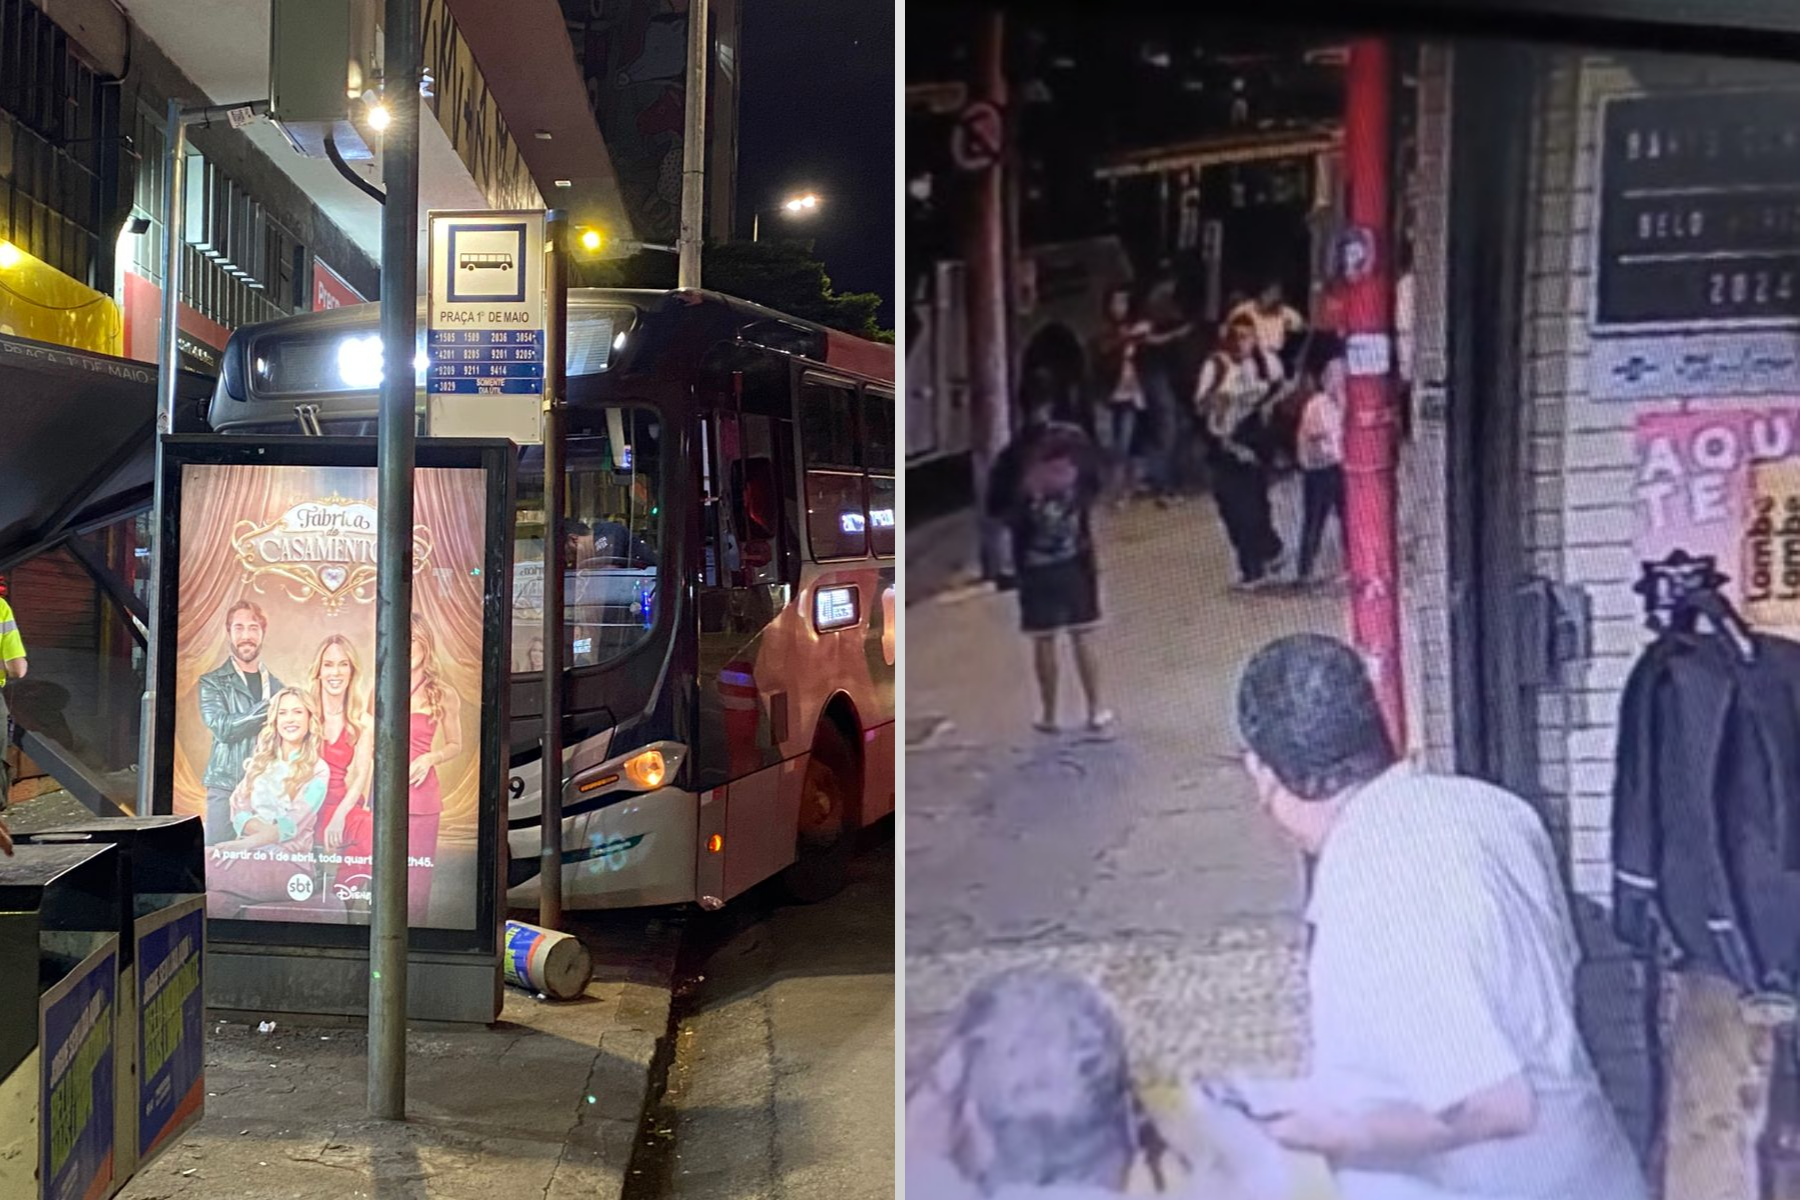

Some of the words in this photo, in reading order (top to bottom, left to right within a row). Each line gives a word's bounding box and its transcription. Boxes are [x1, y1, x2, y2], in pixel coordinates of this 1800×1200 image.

[440, 311, 475, 325] PRAÇA
[488, 311, 502, 322] DE
[503, 311, 529, 323] MAIO
[109, 364, 149, 383] MAIO
[463, 365, 480, 375] 9211
[490, 365, 507, 375] 9414
[1639, 415, 1790, 481] AQU
[212, 848, 221, 859] A
[223, 850, 252, 861] partir
[253, 850, 267, 861] de
[268, 851, 274, 861] 1
[275, 851, 289, 862] de
[290, 852, 316, 863] abril,
[318, 853, 342, 864] toda
[343, 855, 372, 867] quart
[408, 856, 434, 867] 2h45.
[289, 878, 311, 893] sbt
[333, 883, 373, 906] Disney
